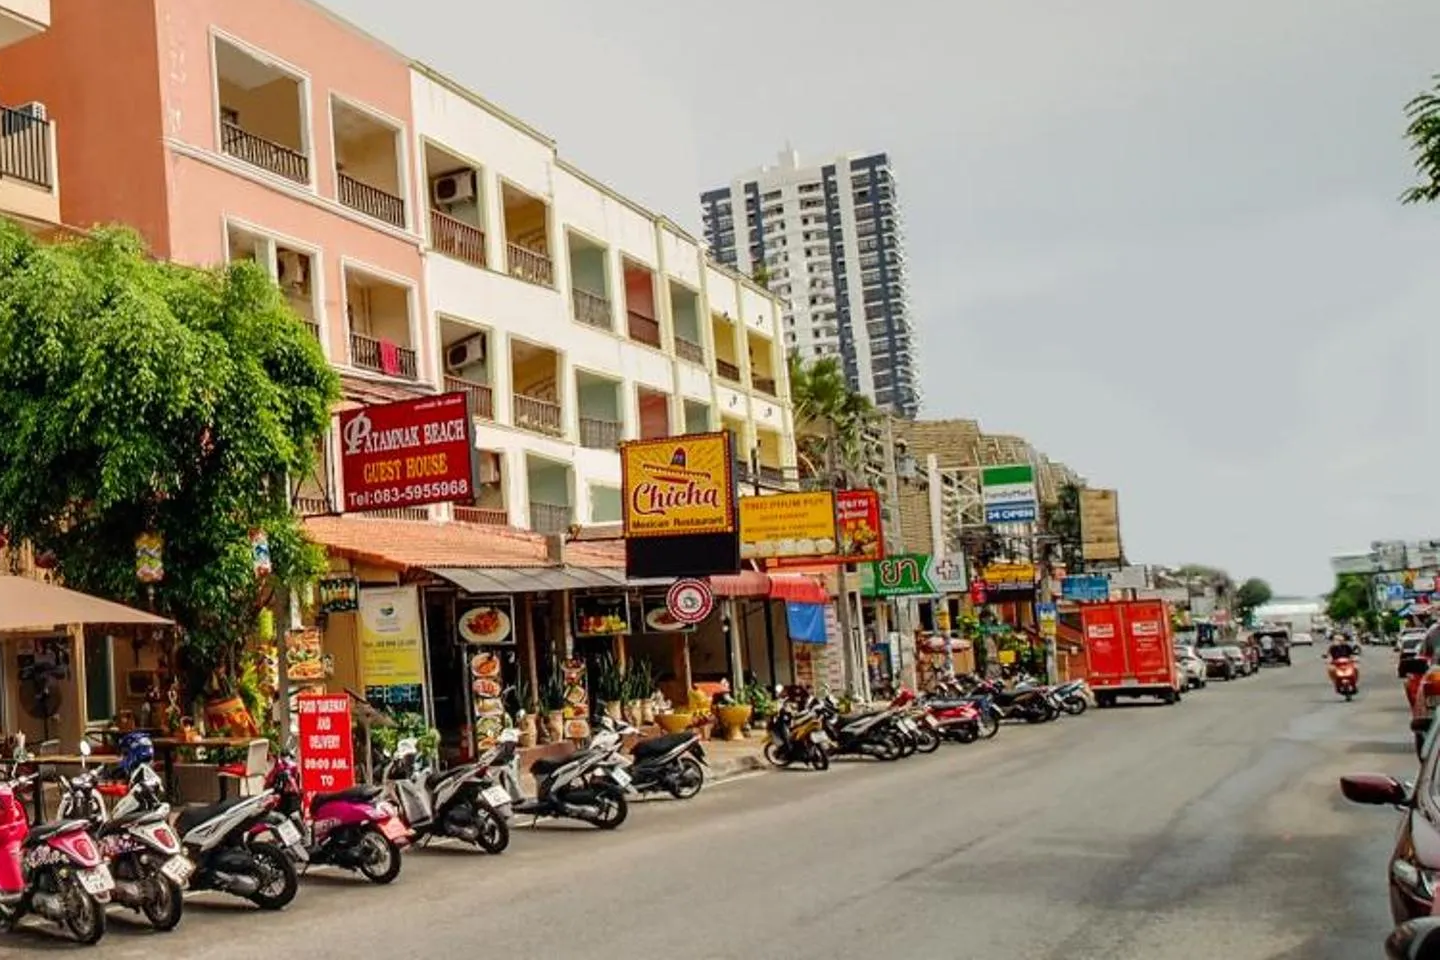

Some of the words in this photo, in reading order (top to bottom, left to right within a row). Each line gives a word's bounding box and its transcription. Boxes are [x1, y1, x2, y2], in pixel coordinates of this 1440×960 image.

[423, 418, 465, 446] BEACH
[363, 458, 402, 484] GUEST
[406, 452, 448, 479] HOUSE
[633, 480, 720, 515] Chicha
[320, 775, 335, 787] TO
